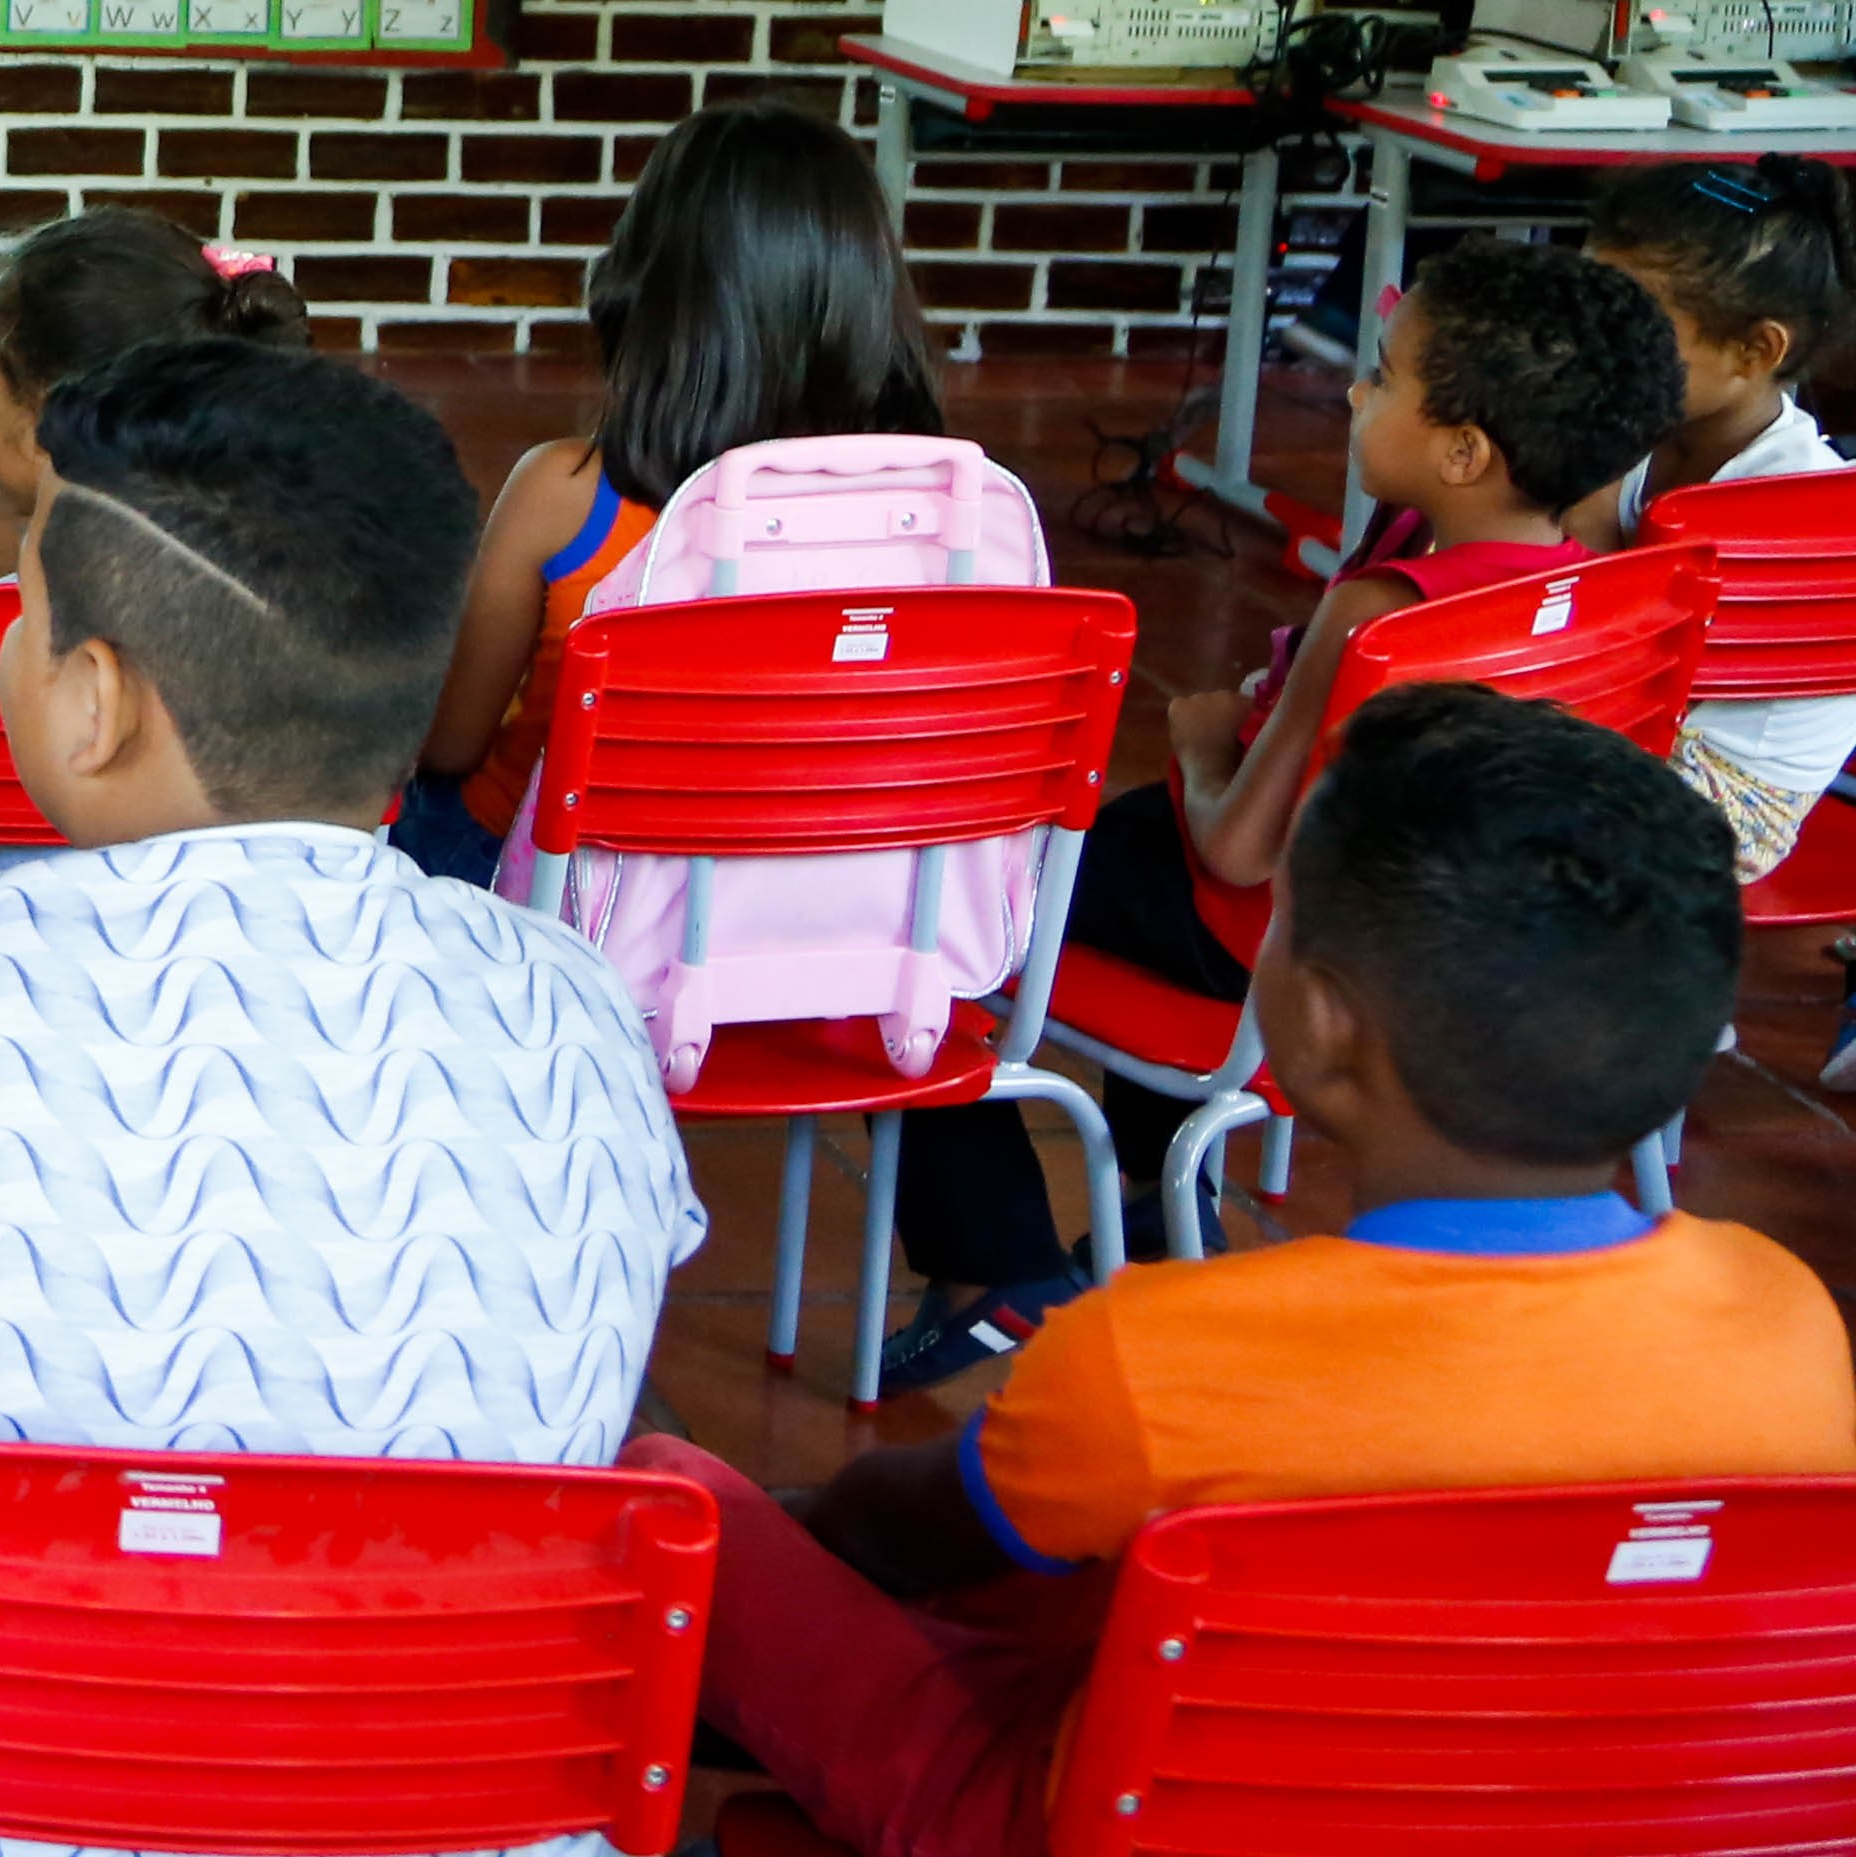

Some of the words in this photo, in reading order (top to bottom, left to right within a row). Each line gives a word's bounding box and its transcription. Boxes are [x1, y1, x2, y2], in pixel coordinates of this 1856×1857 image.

[14, 4, 34, 27] V
[67, 9, 80, 27] v
[106, 4, 134, 28] W
[152, 12, 175, 29] w
[194, 6, 212, 28] X
[246, 12, 259, 29] x
[287, 9, 303, 31] Y
[342, 9, 357, 32] y
[384, 9, 401, 32] Z
[439, 15, 453, 32] z
